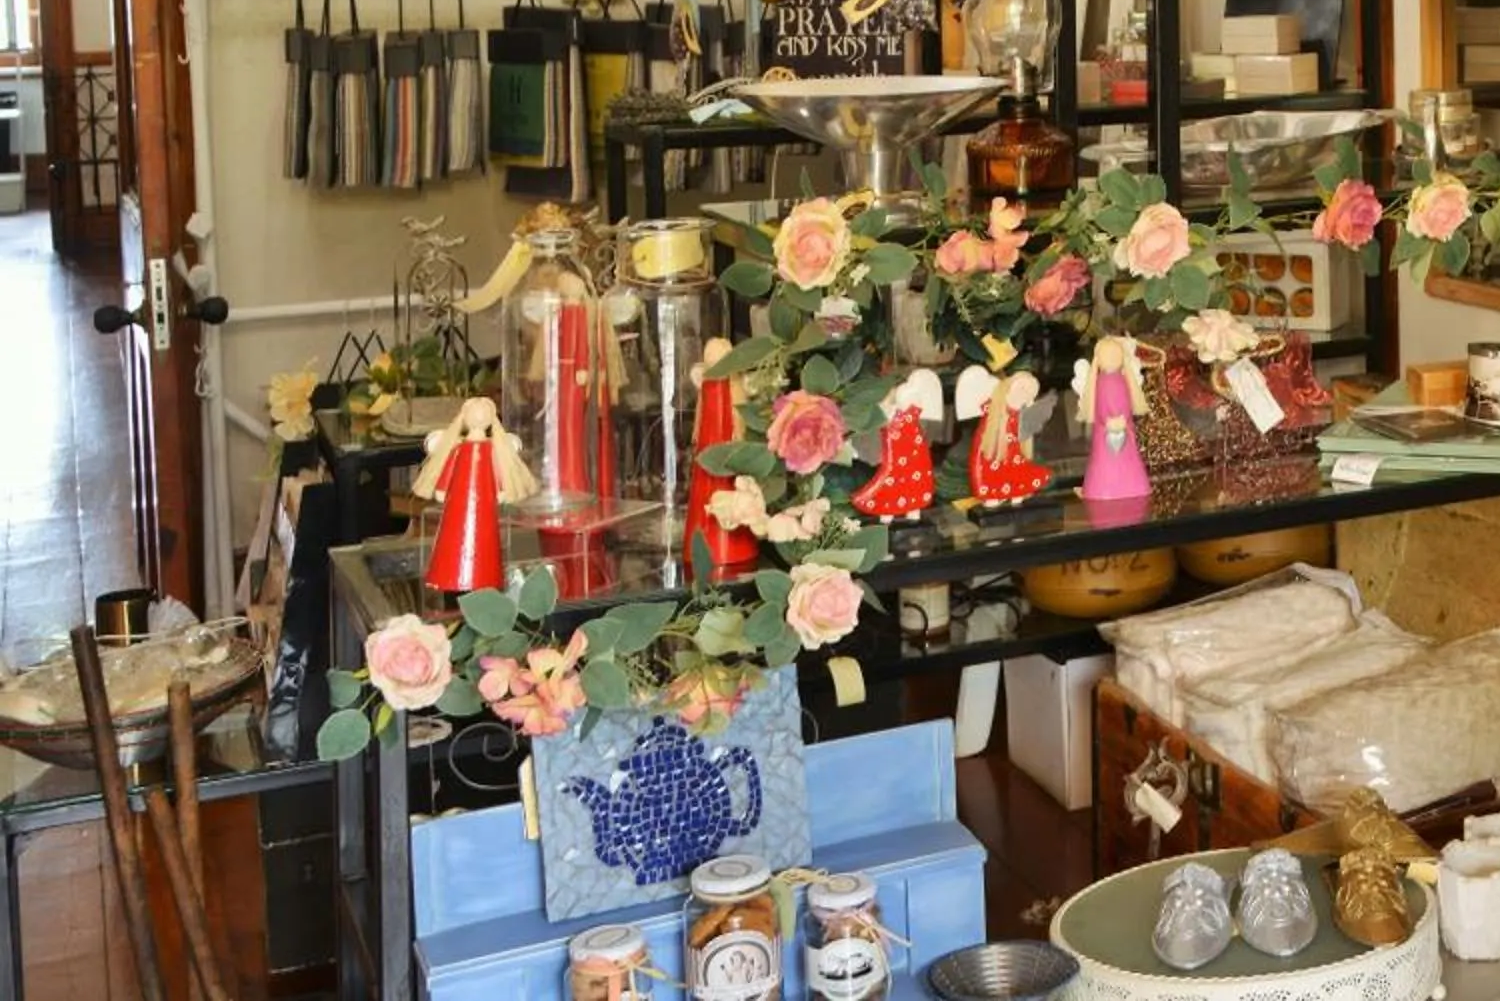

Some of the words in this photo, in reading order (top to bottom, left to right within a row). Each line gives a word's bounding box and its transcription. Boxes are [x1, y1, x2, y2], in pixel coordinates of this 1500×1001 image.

[777, 36, 818, 57] AND
[827, 36, 868, 63] KISS
[876, 36, 903, 57] ME
